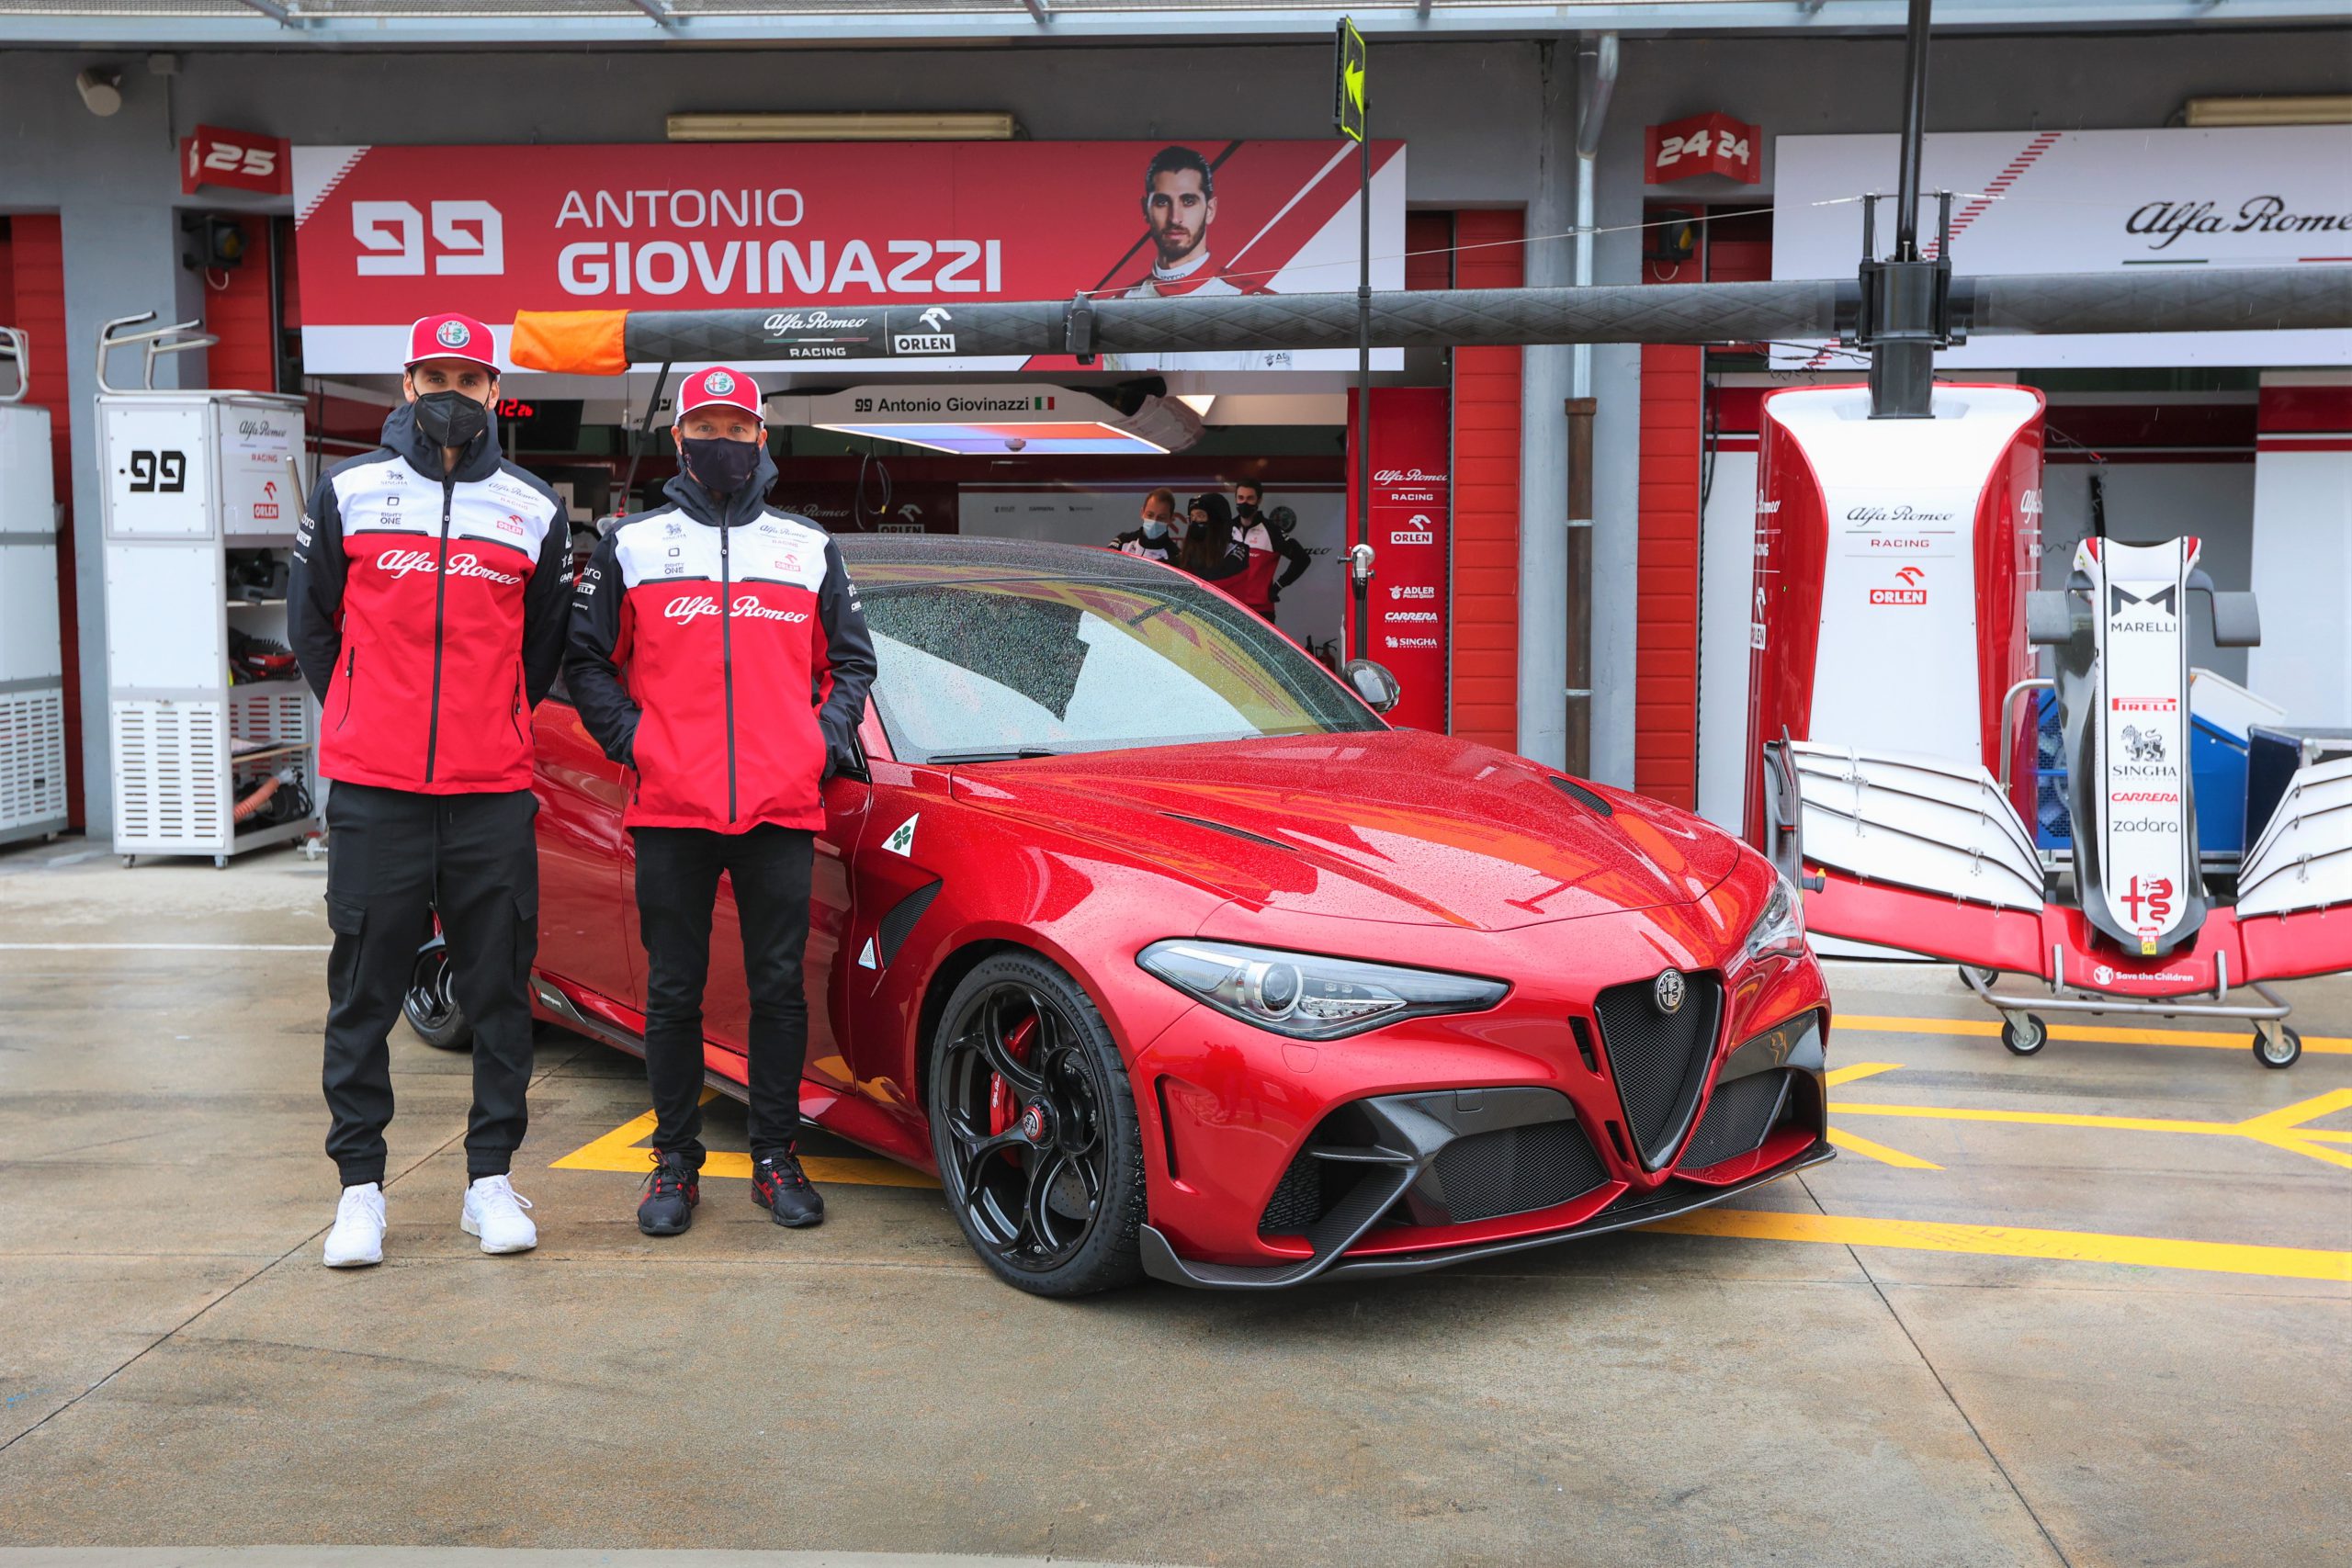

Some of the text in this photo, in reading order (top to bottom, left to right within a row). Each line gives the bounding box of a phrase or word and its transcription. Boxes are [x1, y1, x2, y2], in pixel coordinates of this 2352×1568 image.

[1657, 130, 1713, 167] 24
[1716, 130, 1750, 165] 24
[204, 141, 277, 177] 25
[555, 188, 804, 229] ANTONIO
[2125, 195, 2352, 251] Alfa Rome
[352, 200, 504, 276] 99
[557, 239, 1002, 296] GIOVINAZZI
[763, 310, 868, 336] Alfa Romeo
[898, 337, 951, 351] ORLEN
[789, 346, 846, 357] RACING
[854, 397, 1030, 412] 99 Antonio Giovinazzi
[239, 420, 287, 441] Alfa Romeo
[251, 454, 278, 463] RACING
[130, 451, 187, 492] 99
[1374, 469, 1406, 486] Alfa
[489, 482, 510, 493] Alfa
[254, 505, 277, 517] ORLEN
[1847, 505, 1955, 527] Alfa Romeo
[380, 517, 401, 525] ONE
[498, 521, 523, 536] ORLEN
[760, 524, 808, 538] Alfa Romeo
[1393, 534, 1430, 542] ORLEN
[1871, 538, 1930, 548] RACING
[377, 549, 523, 585] Alfa Romeo
[664, 567, 684, 575] ONE
[1872, 591, 1924, 604] ORLEN
[663, 595, 809, 626] Alfa Romeo
[1385, 612, 1438, 621] CARRERA
[2111, 622, 2177, 633] MARELLI
[1399, 637, 1438, 646] SINGHA
[2111, 697, 2177, 711] PIRELLI
[2112, 765, 2177, 777] SINGHA
[2111, 793, 2179, 802] CARRERA
[2113, 818, 2178, 833] zadara
[2116, 972, 2194, 982] Save the Children
